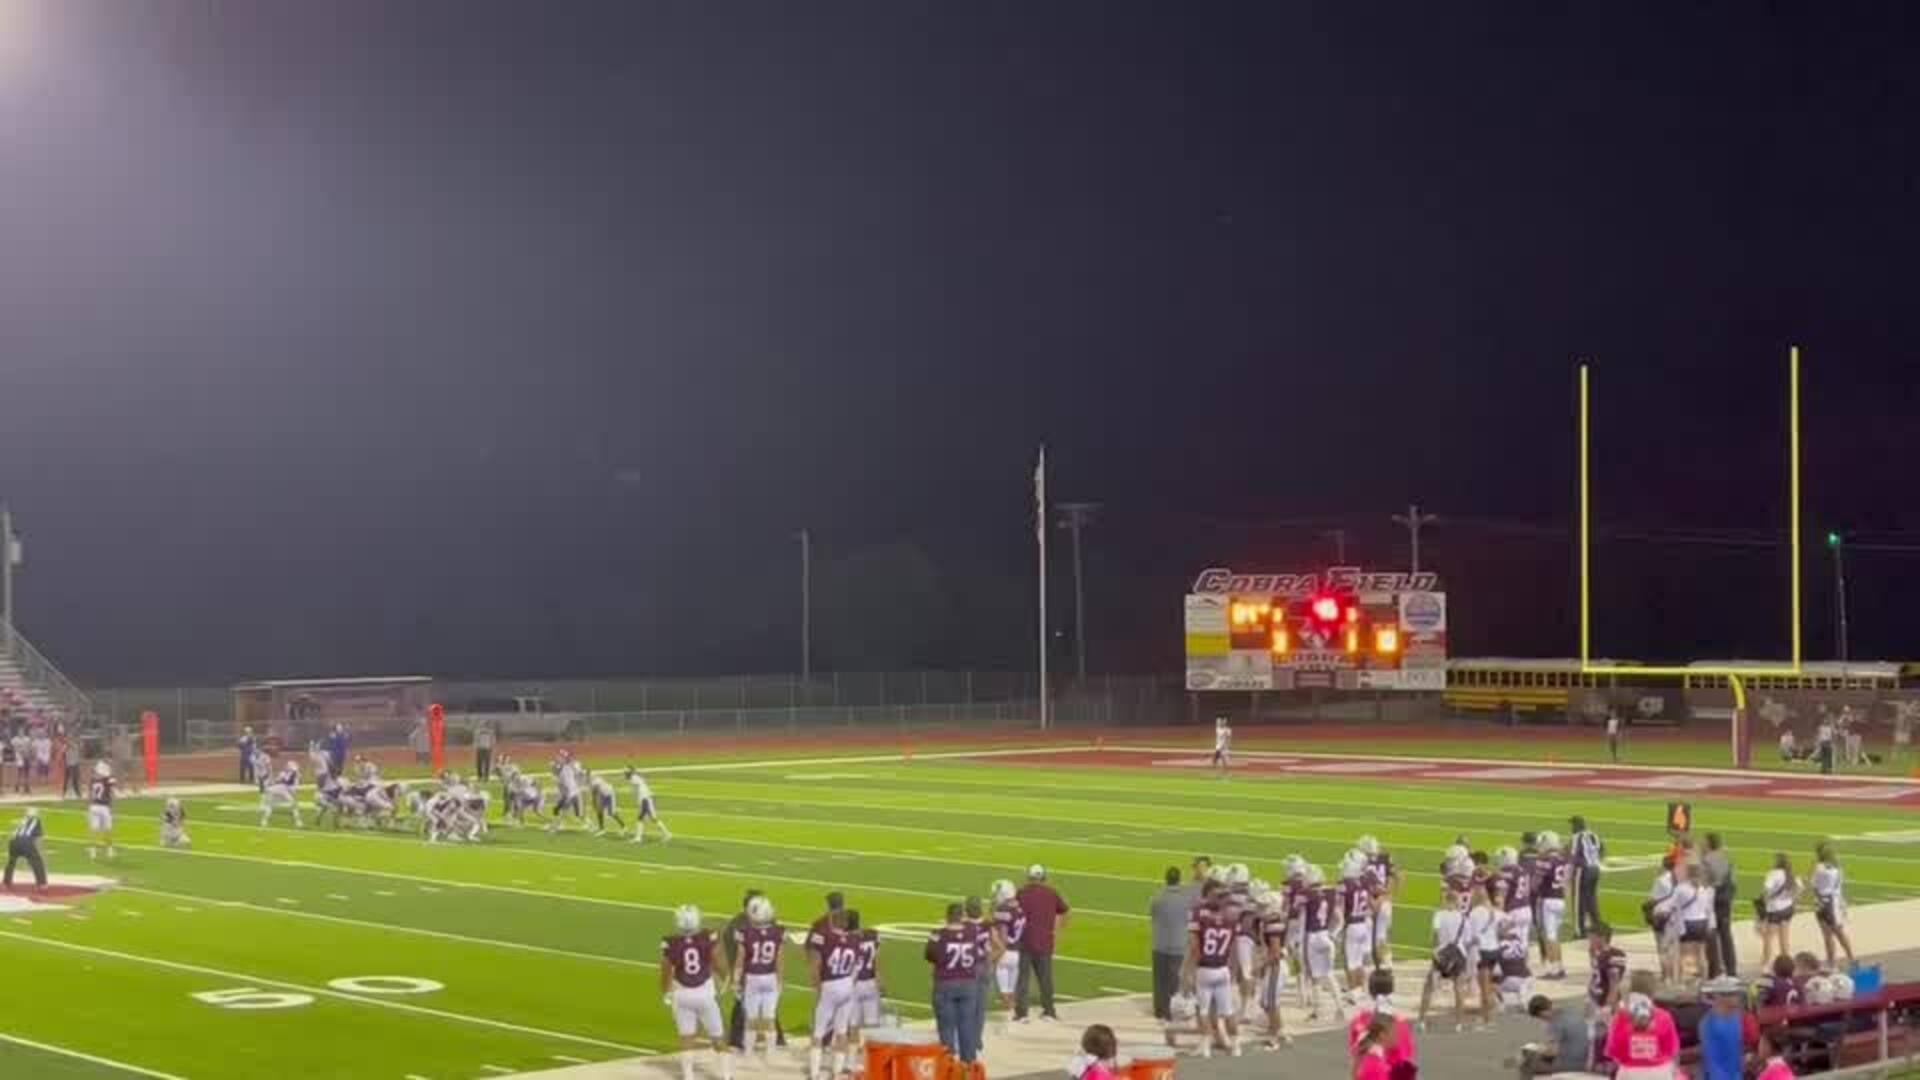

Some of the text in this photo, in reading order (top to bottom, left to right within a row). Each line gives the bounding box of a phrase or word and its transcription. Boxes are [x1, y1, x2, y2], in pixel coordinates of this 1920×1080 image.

[751, 940, 776, 965] 19
[946, 942, 975, 968] 75
[1203, 928, 1232, 956] 67
[684, 947, 701, 975] 8
[827, 946, 855, 975] 40
